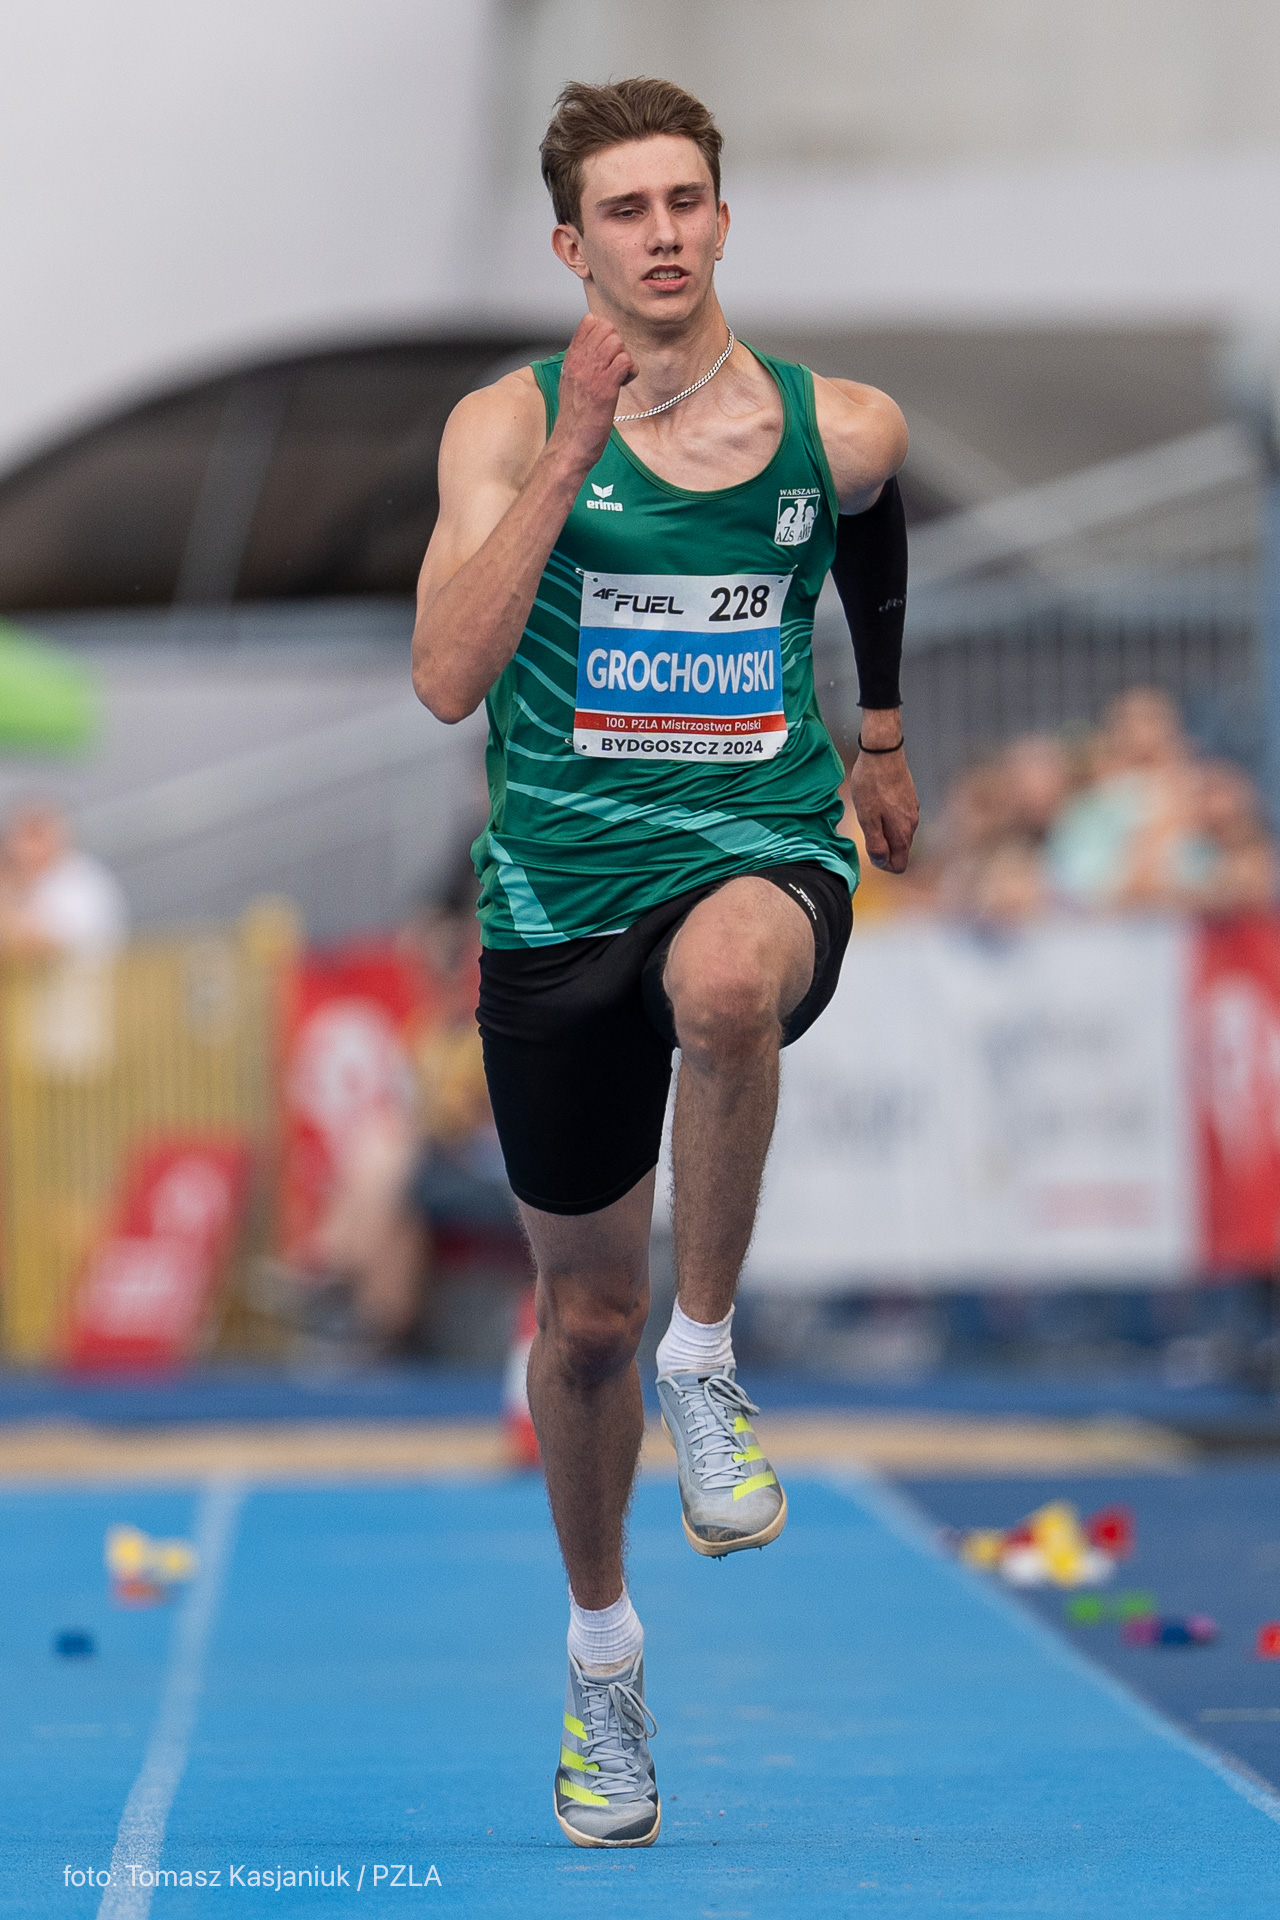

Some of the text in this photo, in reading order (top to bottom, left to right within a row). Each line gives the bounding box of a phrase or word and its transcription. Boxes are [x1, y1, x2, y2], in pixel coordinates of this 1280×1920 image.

[586, 499, 623, 512] erima
[708, 585, 770, 622] 228
[586, 648, 775, 694] GROCHOWSKI
[605, 717, 761, 732] 100. PZLA Mistrzostwa Polski
[601, 738, 763, 755] BYDGOSZCZ 2024
